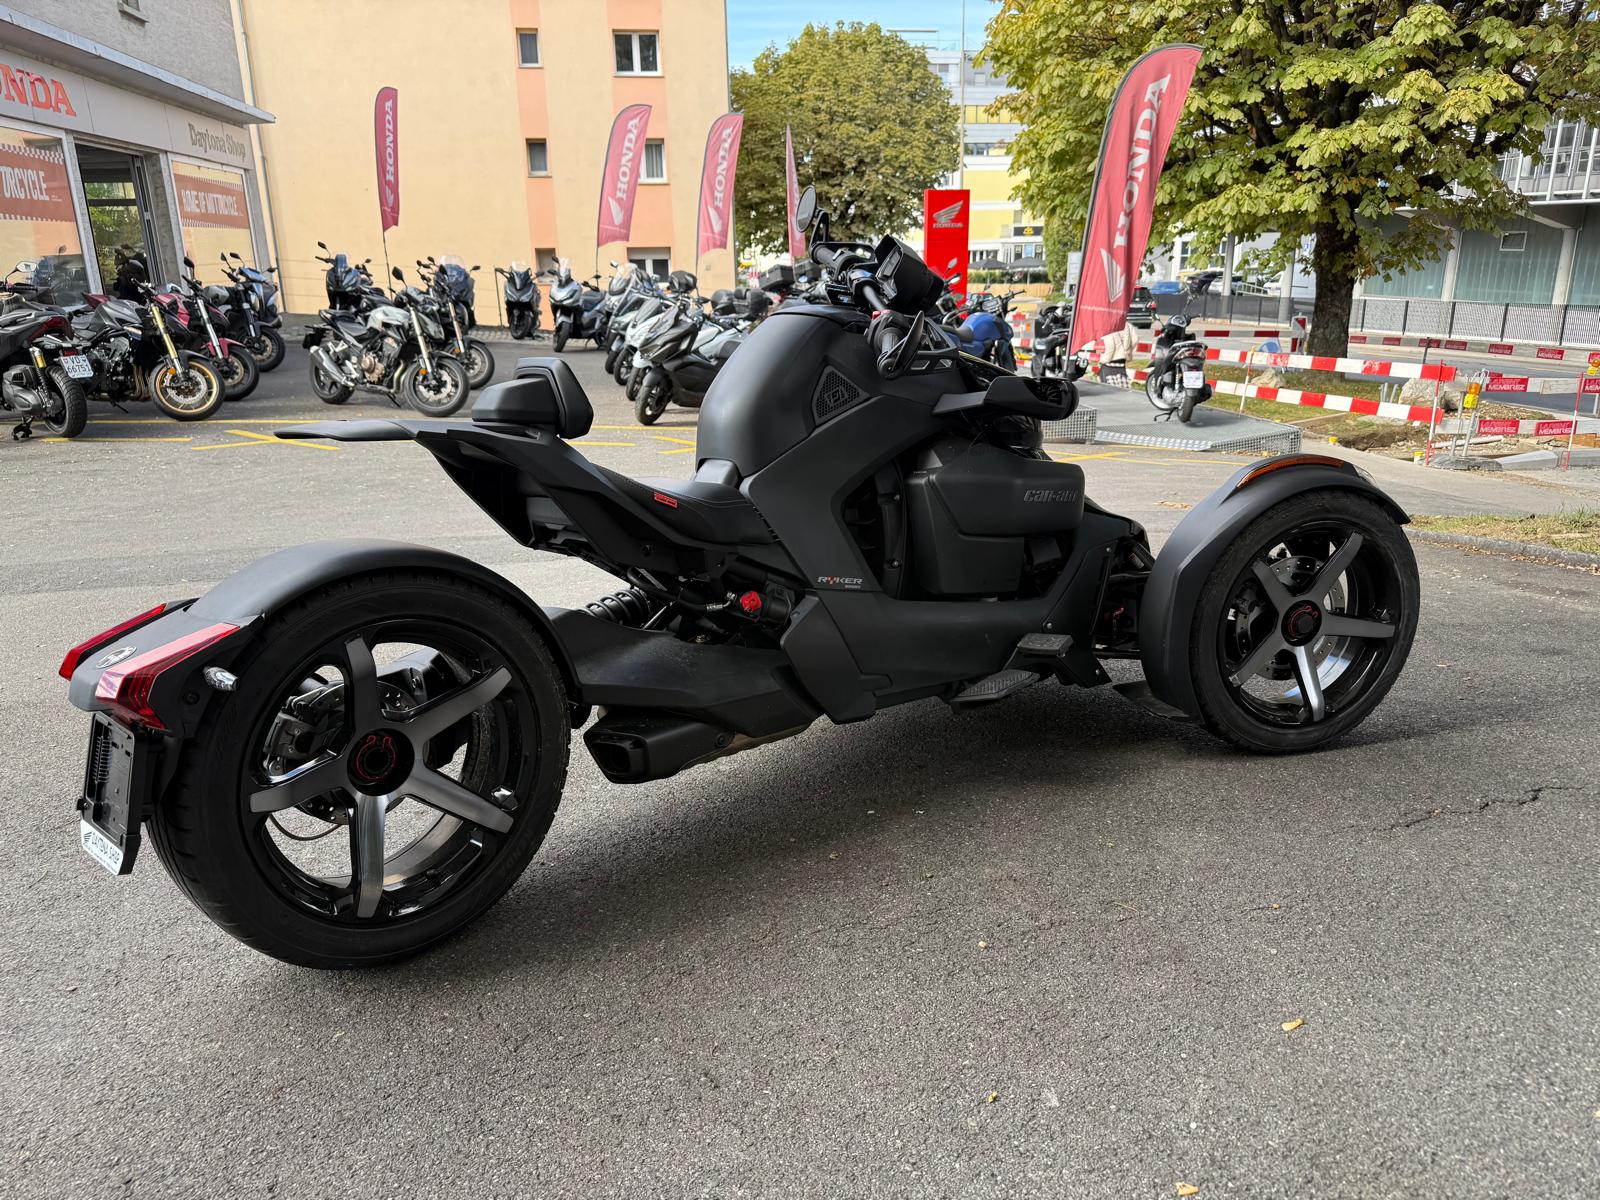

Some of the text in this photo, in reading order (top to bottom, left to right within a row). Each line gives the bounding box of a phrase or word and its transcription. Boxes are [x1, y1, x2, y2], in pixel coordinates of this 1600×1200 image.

[0, 63, 77, 117] NDA
[188, 122, 246, 162] Daytona Shop
[384, 98, 395, 184] HONDA
[615, 116, 641, 201] HONDA
[714, 126, 734, 209] HONDA
[1113, 73, 1172, 249] HONDA
[817, 576, 863, 585] RYKER
